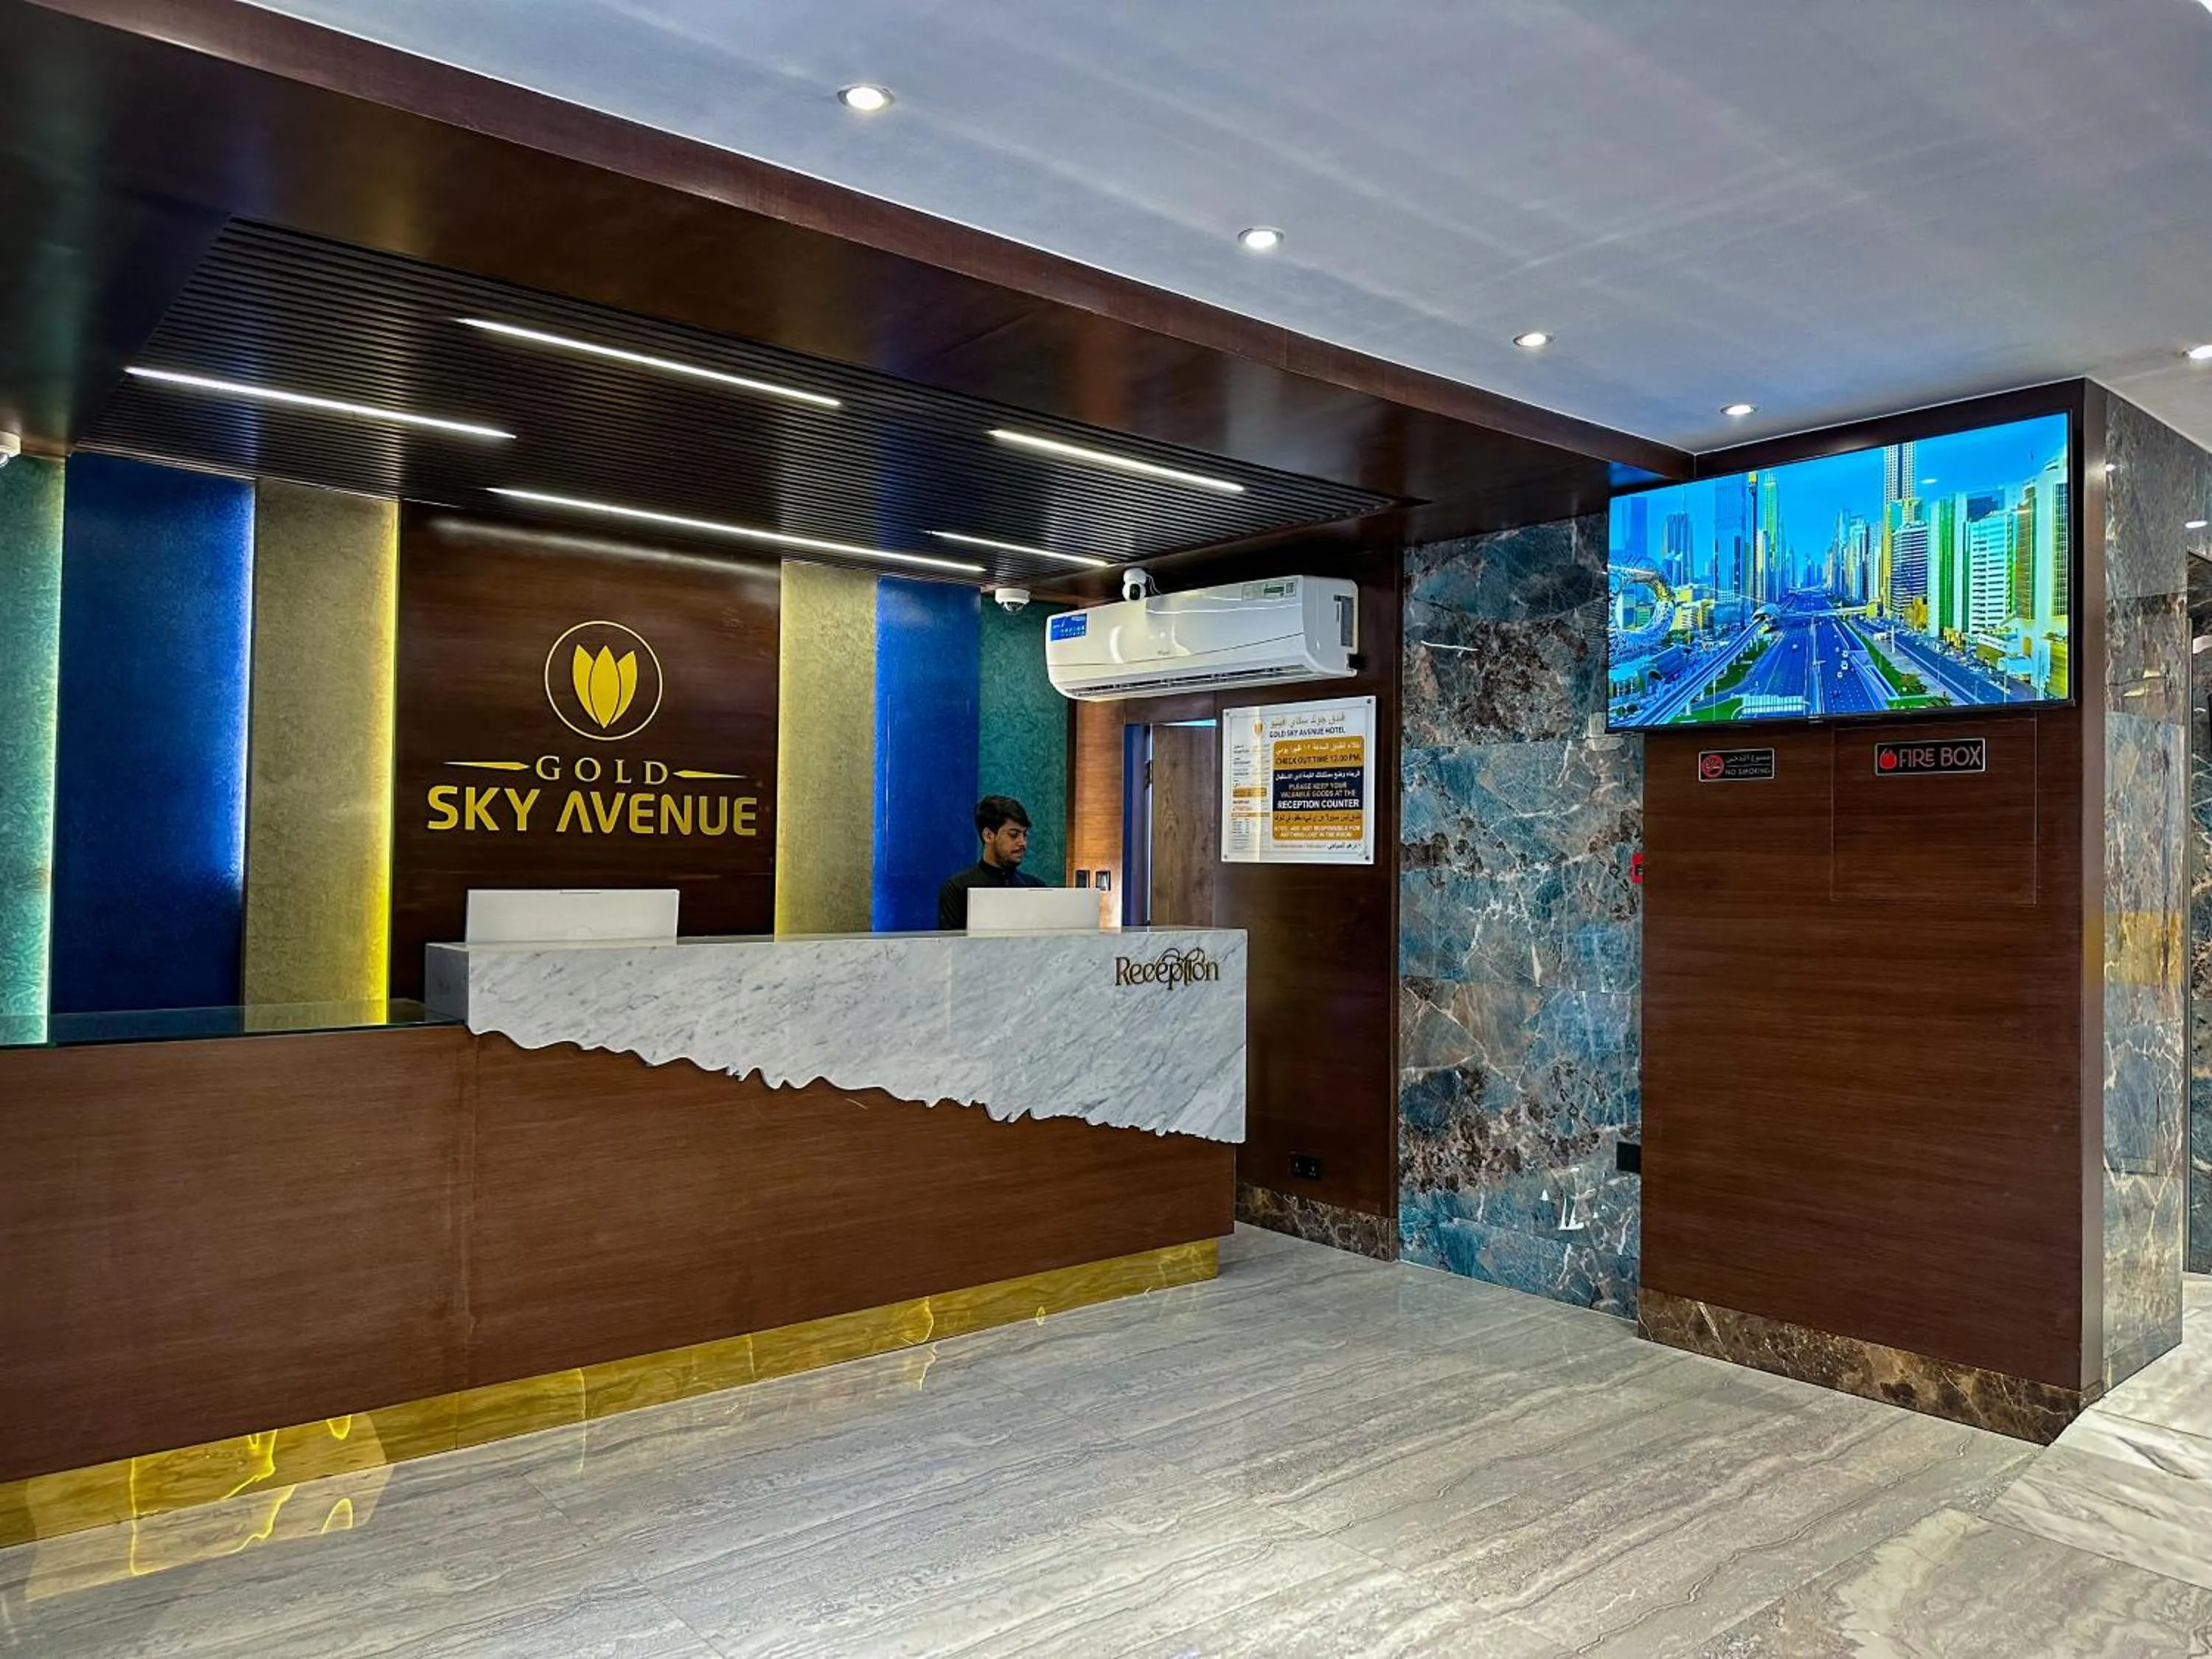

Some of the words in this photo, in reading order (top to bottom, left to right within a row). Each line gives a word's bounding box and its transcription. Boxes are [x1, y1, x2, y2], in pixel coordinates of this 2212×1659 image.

[1269, 730, 1286, 738] GOLD
[1298, 728, 1324, 737] AVENUE
[1276, 757, 1297, 765] CHECK
[1298, 756, 1310, 764] OUT
[1310, 755, 1328, 763] TIME
[1899, 748, 1935, 768] FIRE
[1940, 745, 1981, 768] BOX
[535, 755, 669, 786] GOLD
[1738, 767, 1771, 775] SMOKING
[1288, 782, 1312, 790] PLEASE
[1280, 790, 1311, 799] VALUABLE
[1276, 800, 1321, 809] RECEPTION
[1321, 799, 1360, 808] COUNTER
[428, 785, 540, 831] SKY
[556, 791, 758, 836] AVENUE
[1115, 947, 1220, 990] Reception
